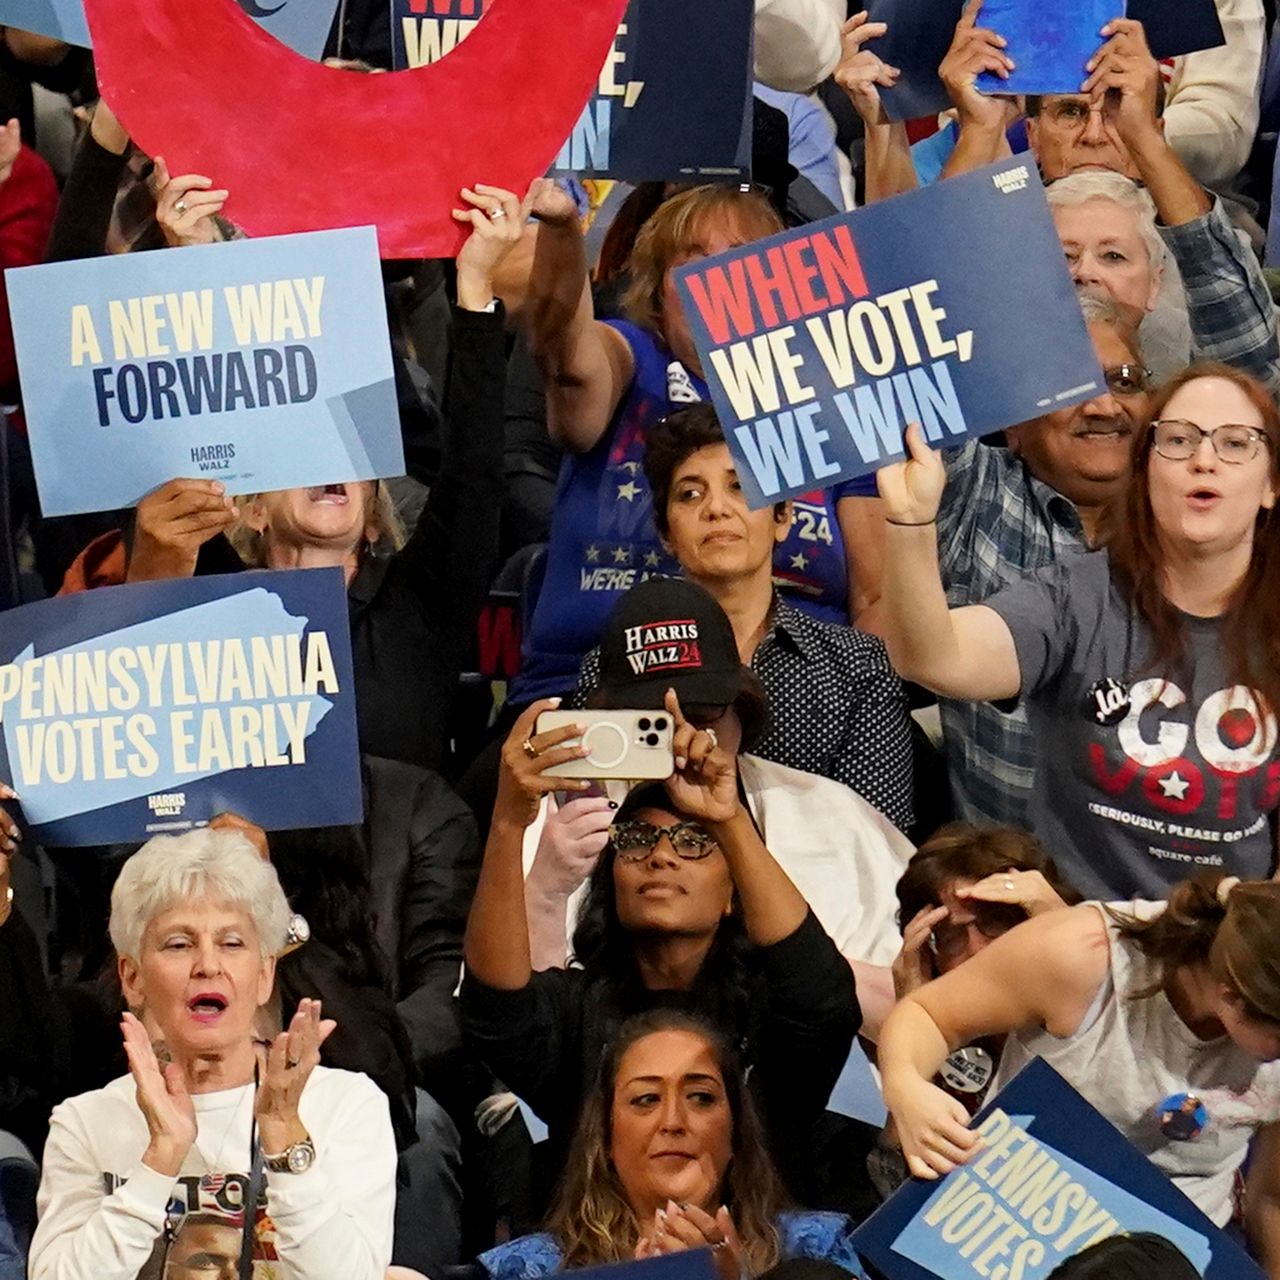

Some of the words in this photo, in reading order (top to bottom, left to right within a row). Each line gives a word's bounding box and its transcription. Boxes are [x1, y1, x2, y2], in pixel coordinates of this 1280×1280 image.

[685, 225, 869, 345] WHEN
[71, 304, 101, 367] A
[110, 289, 214, 359] NEW
[224, 275, 325, 344] WAY
[709, 328, 816, 421] WE
[803, 278, 973, 378] VOTE,
[93, 344, 318, 427] FORWARD
[191, 443, 235, 464] HARRIS
[733, 415, 842, 497] WE
[833, 360, 969, 462] WIN
[199, 459, 230, 472] WALZ
[625, 623, 698, 655] HARRIS
[627, 647, 679, 676] WALZ
[679, 641, 701, 663] 24
[16, 711, 159, 786] VOTES
[171, 699, 313, 773] EARLY
[1117, 677, 1278, 773] GO
[148, 792, 186, 809] HARRIS
[1148, 845, 1192, 865] square
[1168, 823, 1221, 842] PLEASE
[1223, 831, 1243, 842] GO
